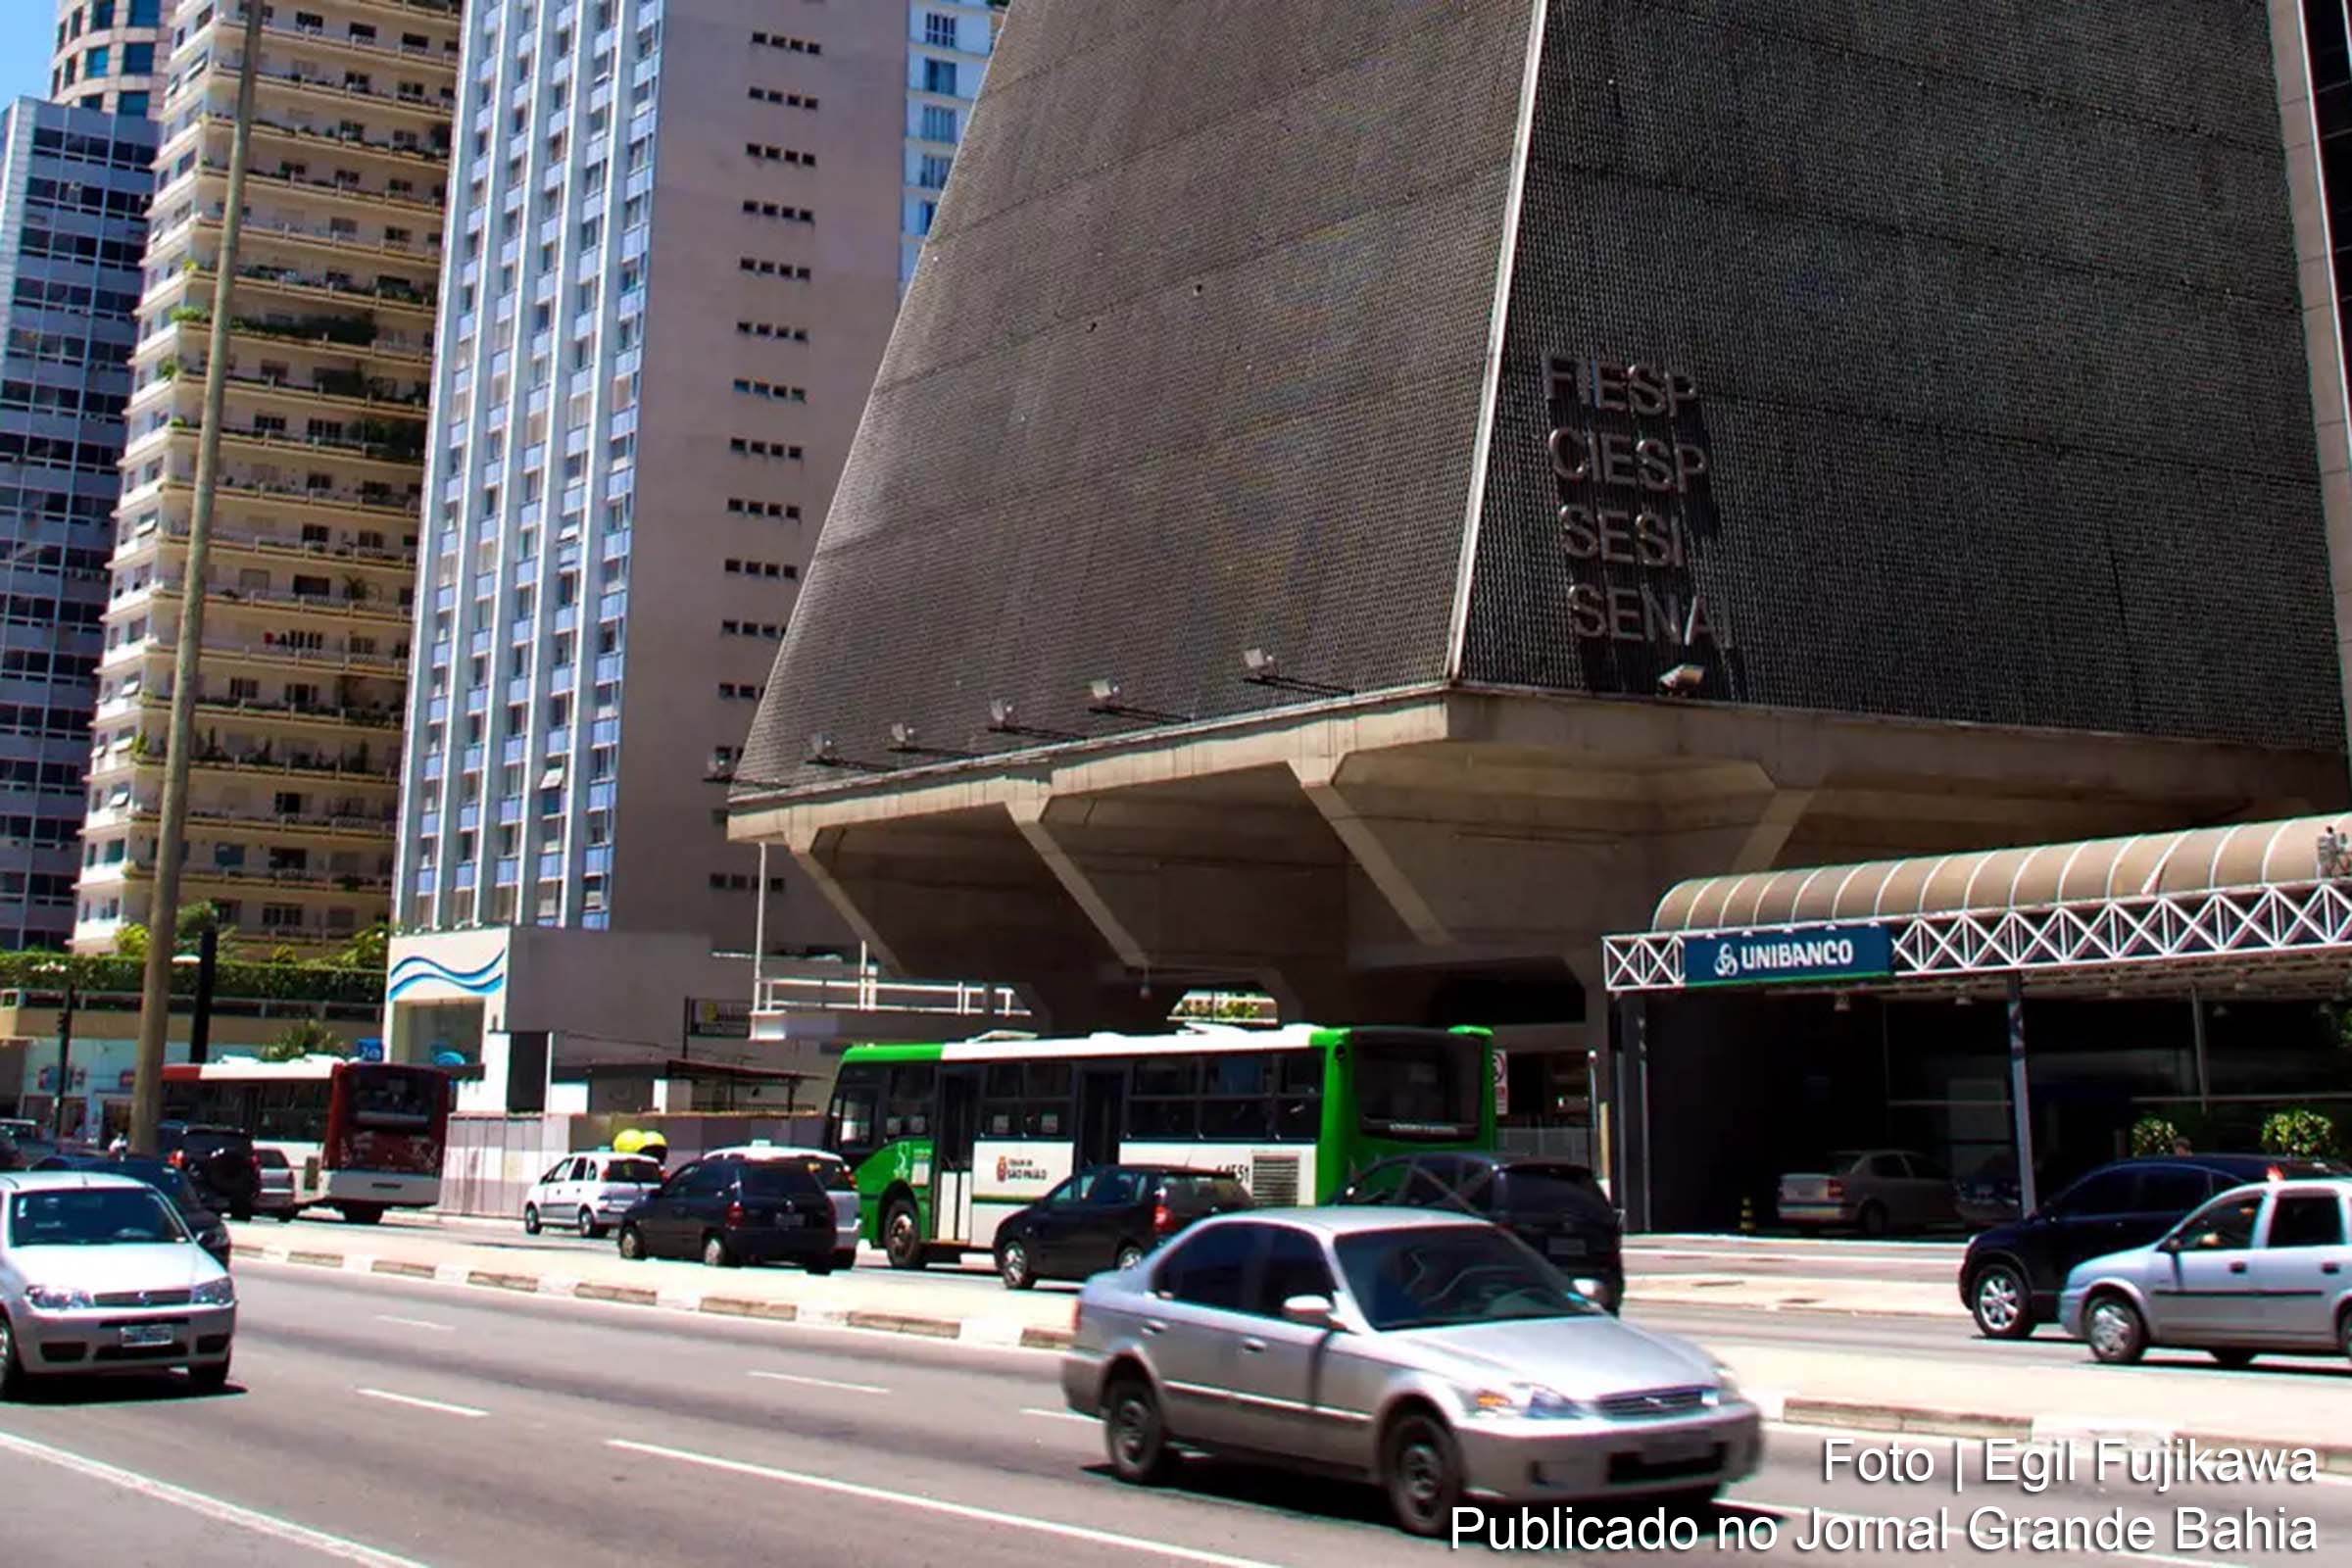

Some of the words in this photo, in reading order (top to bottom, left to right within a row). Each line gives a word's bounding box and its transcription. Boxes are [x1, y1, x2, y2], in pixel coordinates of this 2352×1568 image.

[1542, 351, 1698, 418] FIESP
[1548, 426, 1708, 494] CIESP
[1558, 503, 1686, 568] SESI
[1569, 583, 1734, 651] SENAI
[1740, 938, 1854, 970] UNIBANCO
